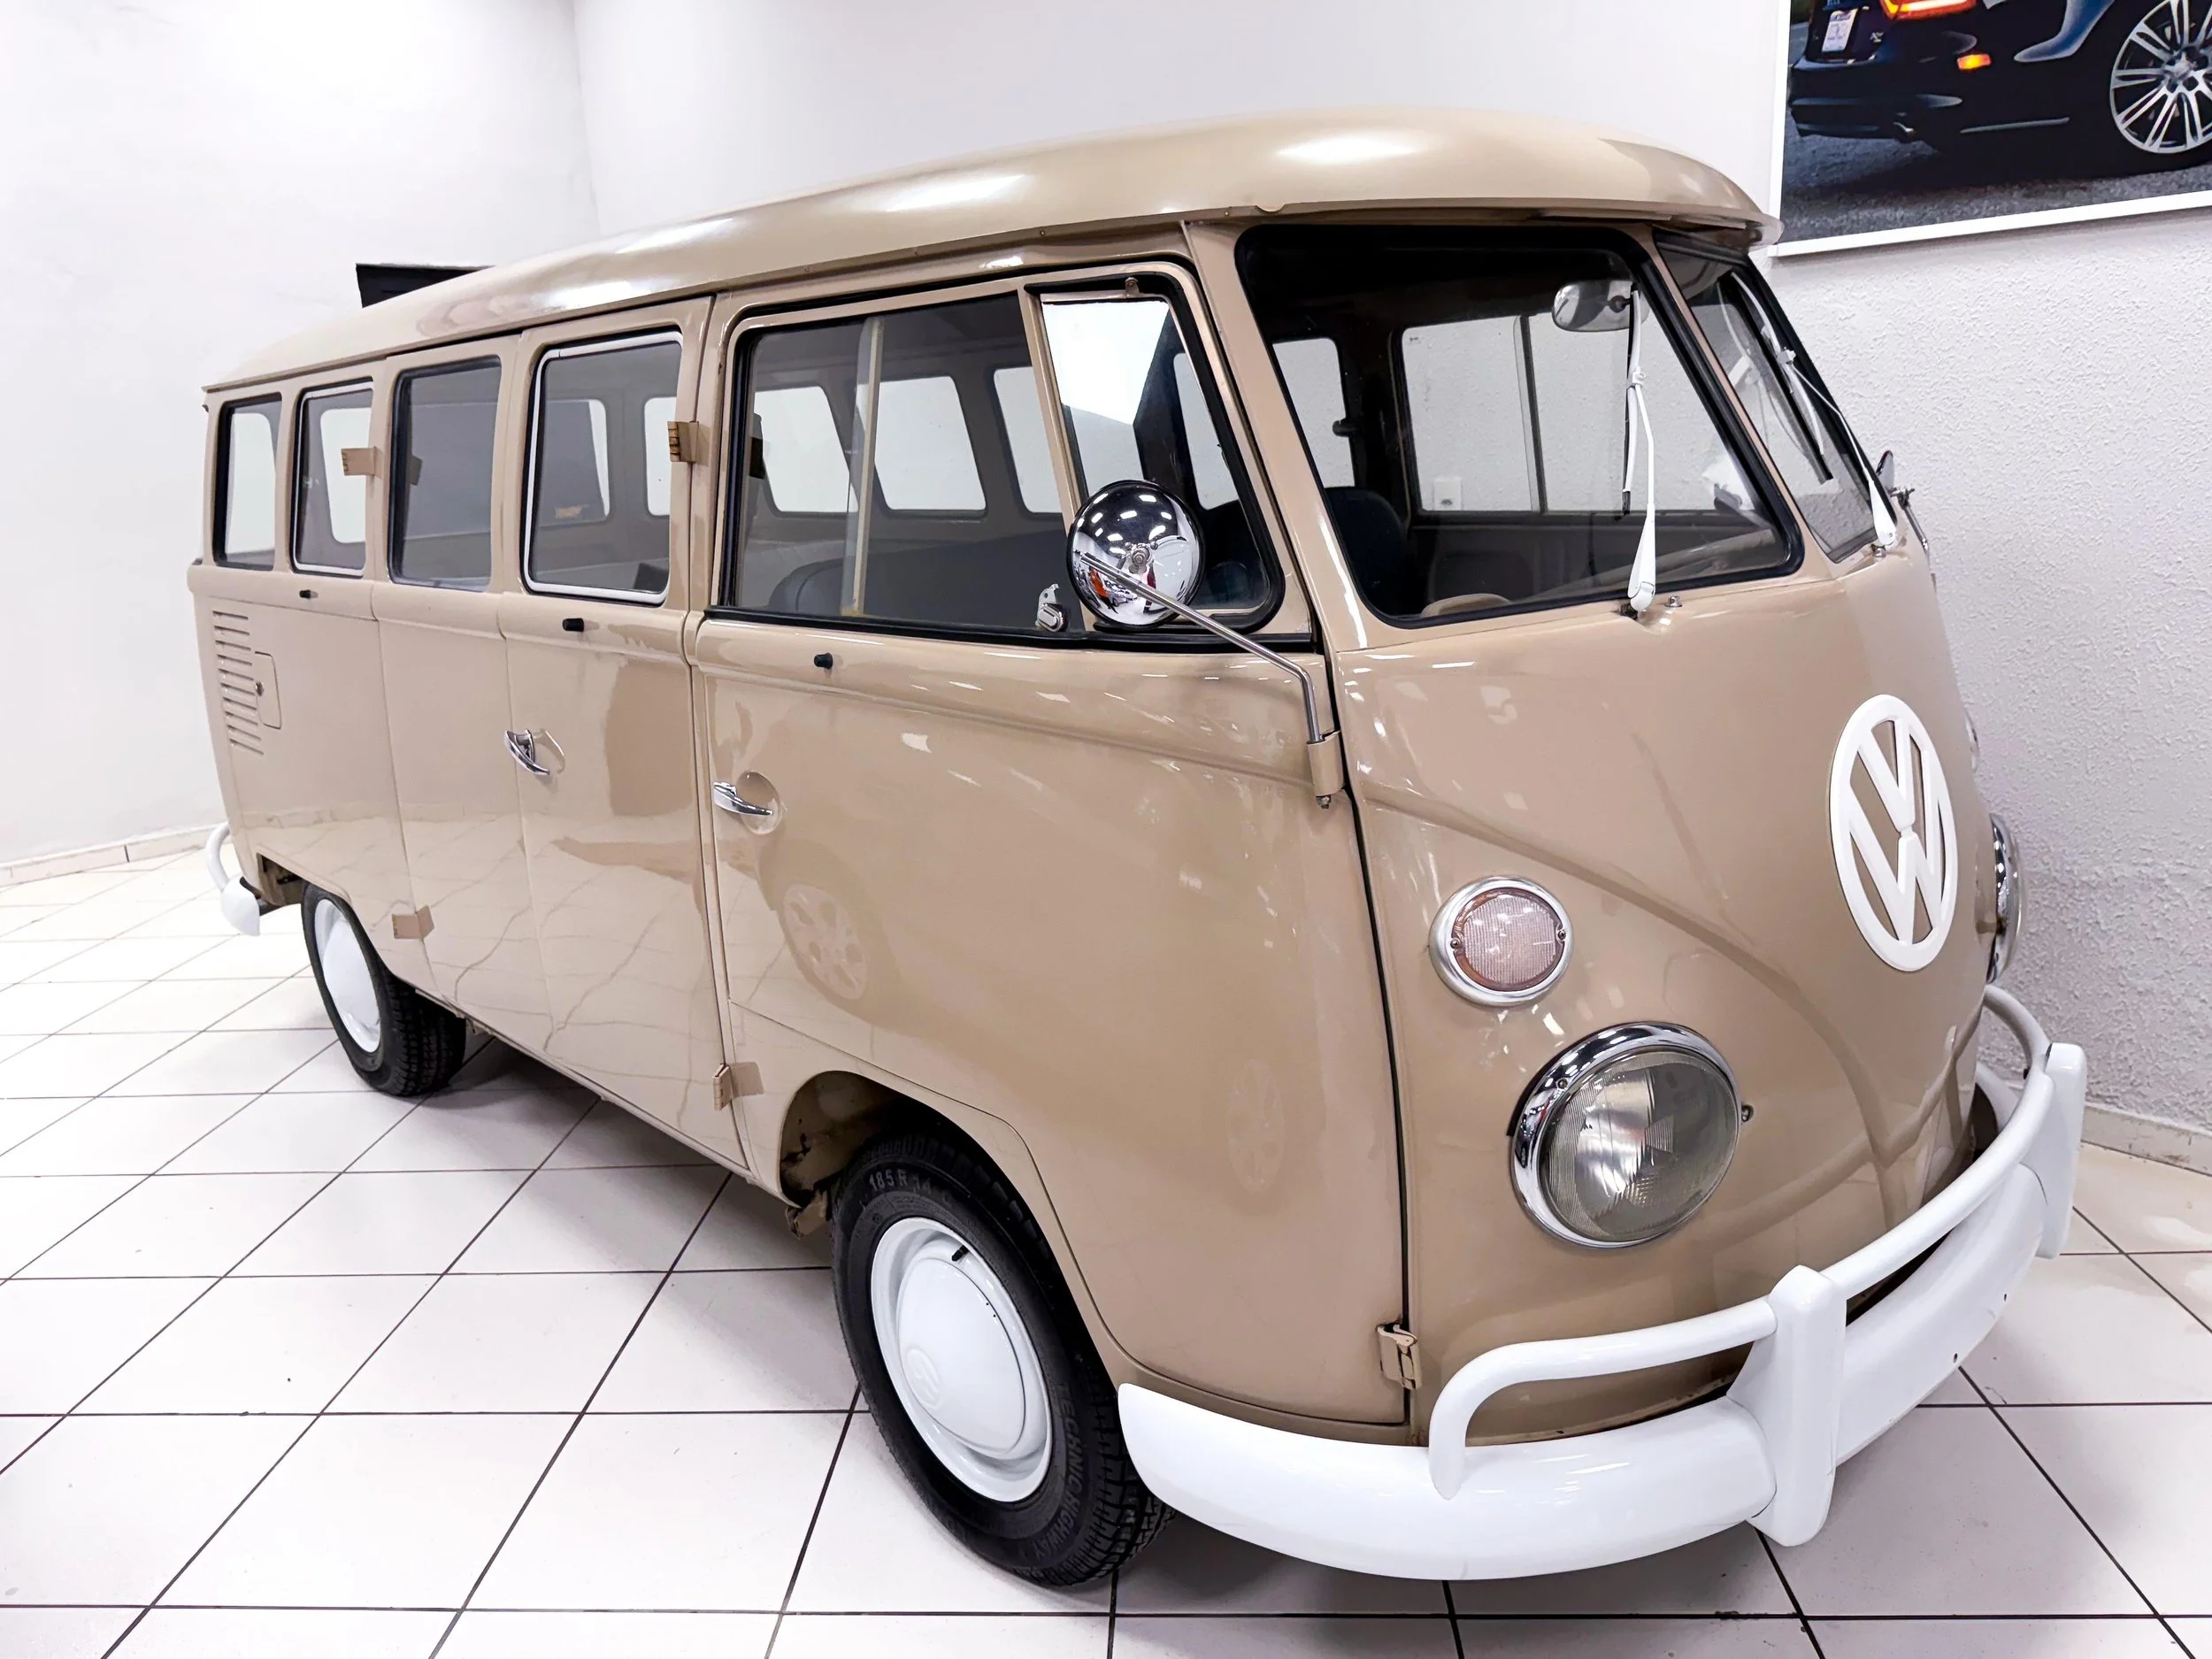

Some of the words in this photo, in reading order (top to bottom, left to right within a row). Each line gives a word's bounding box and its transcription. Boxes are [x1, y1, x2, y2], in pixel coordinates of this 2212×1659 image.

[1835, 702, 1954, 963] VW
[1057, 1381, 1084, 1494] TECHNIC
[1033, 1490, 1080, 1561] HIGHWAY
